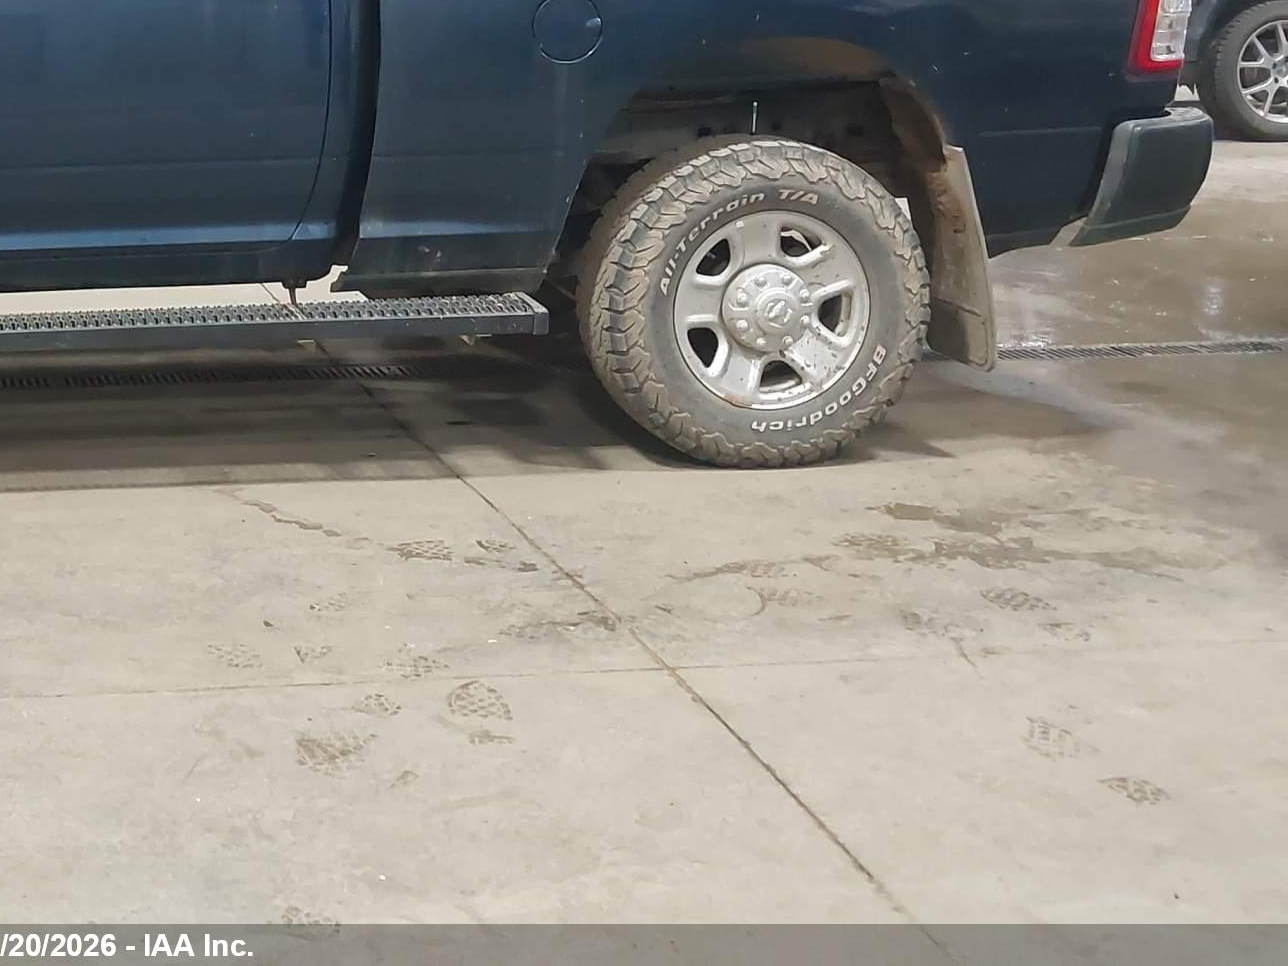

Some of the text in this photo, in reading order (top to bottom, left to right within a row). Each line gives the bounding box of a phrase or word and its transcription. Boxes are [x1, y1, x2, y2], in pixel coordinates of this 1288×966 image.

[660, 188, 819, 296] All-Terrain T/A
[751, 344, 887, 432] BFGoodrich
